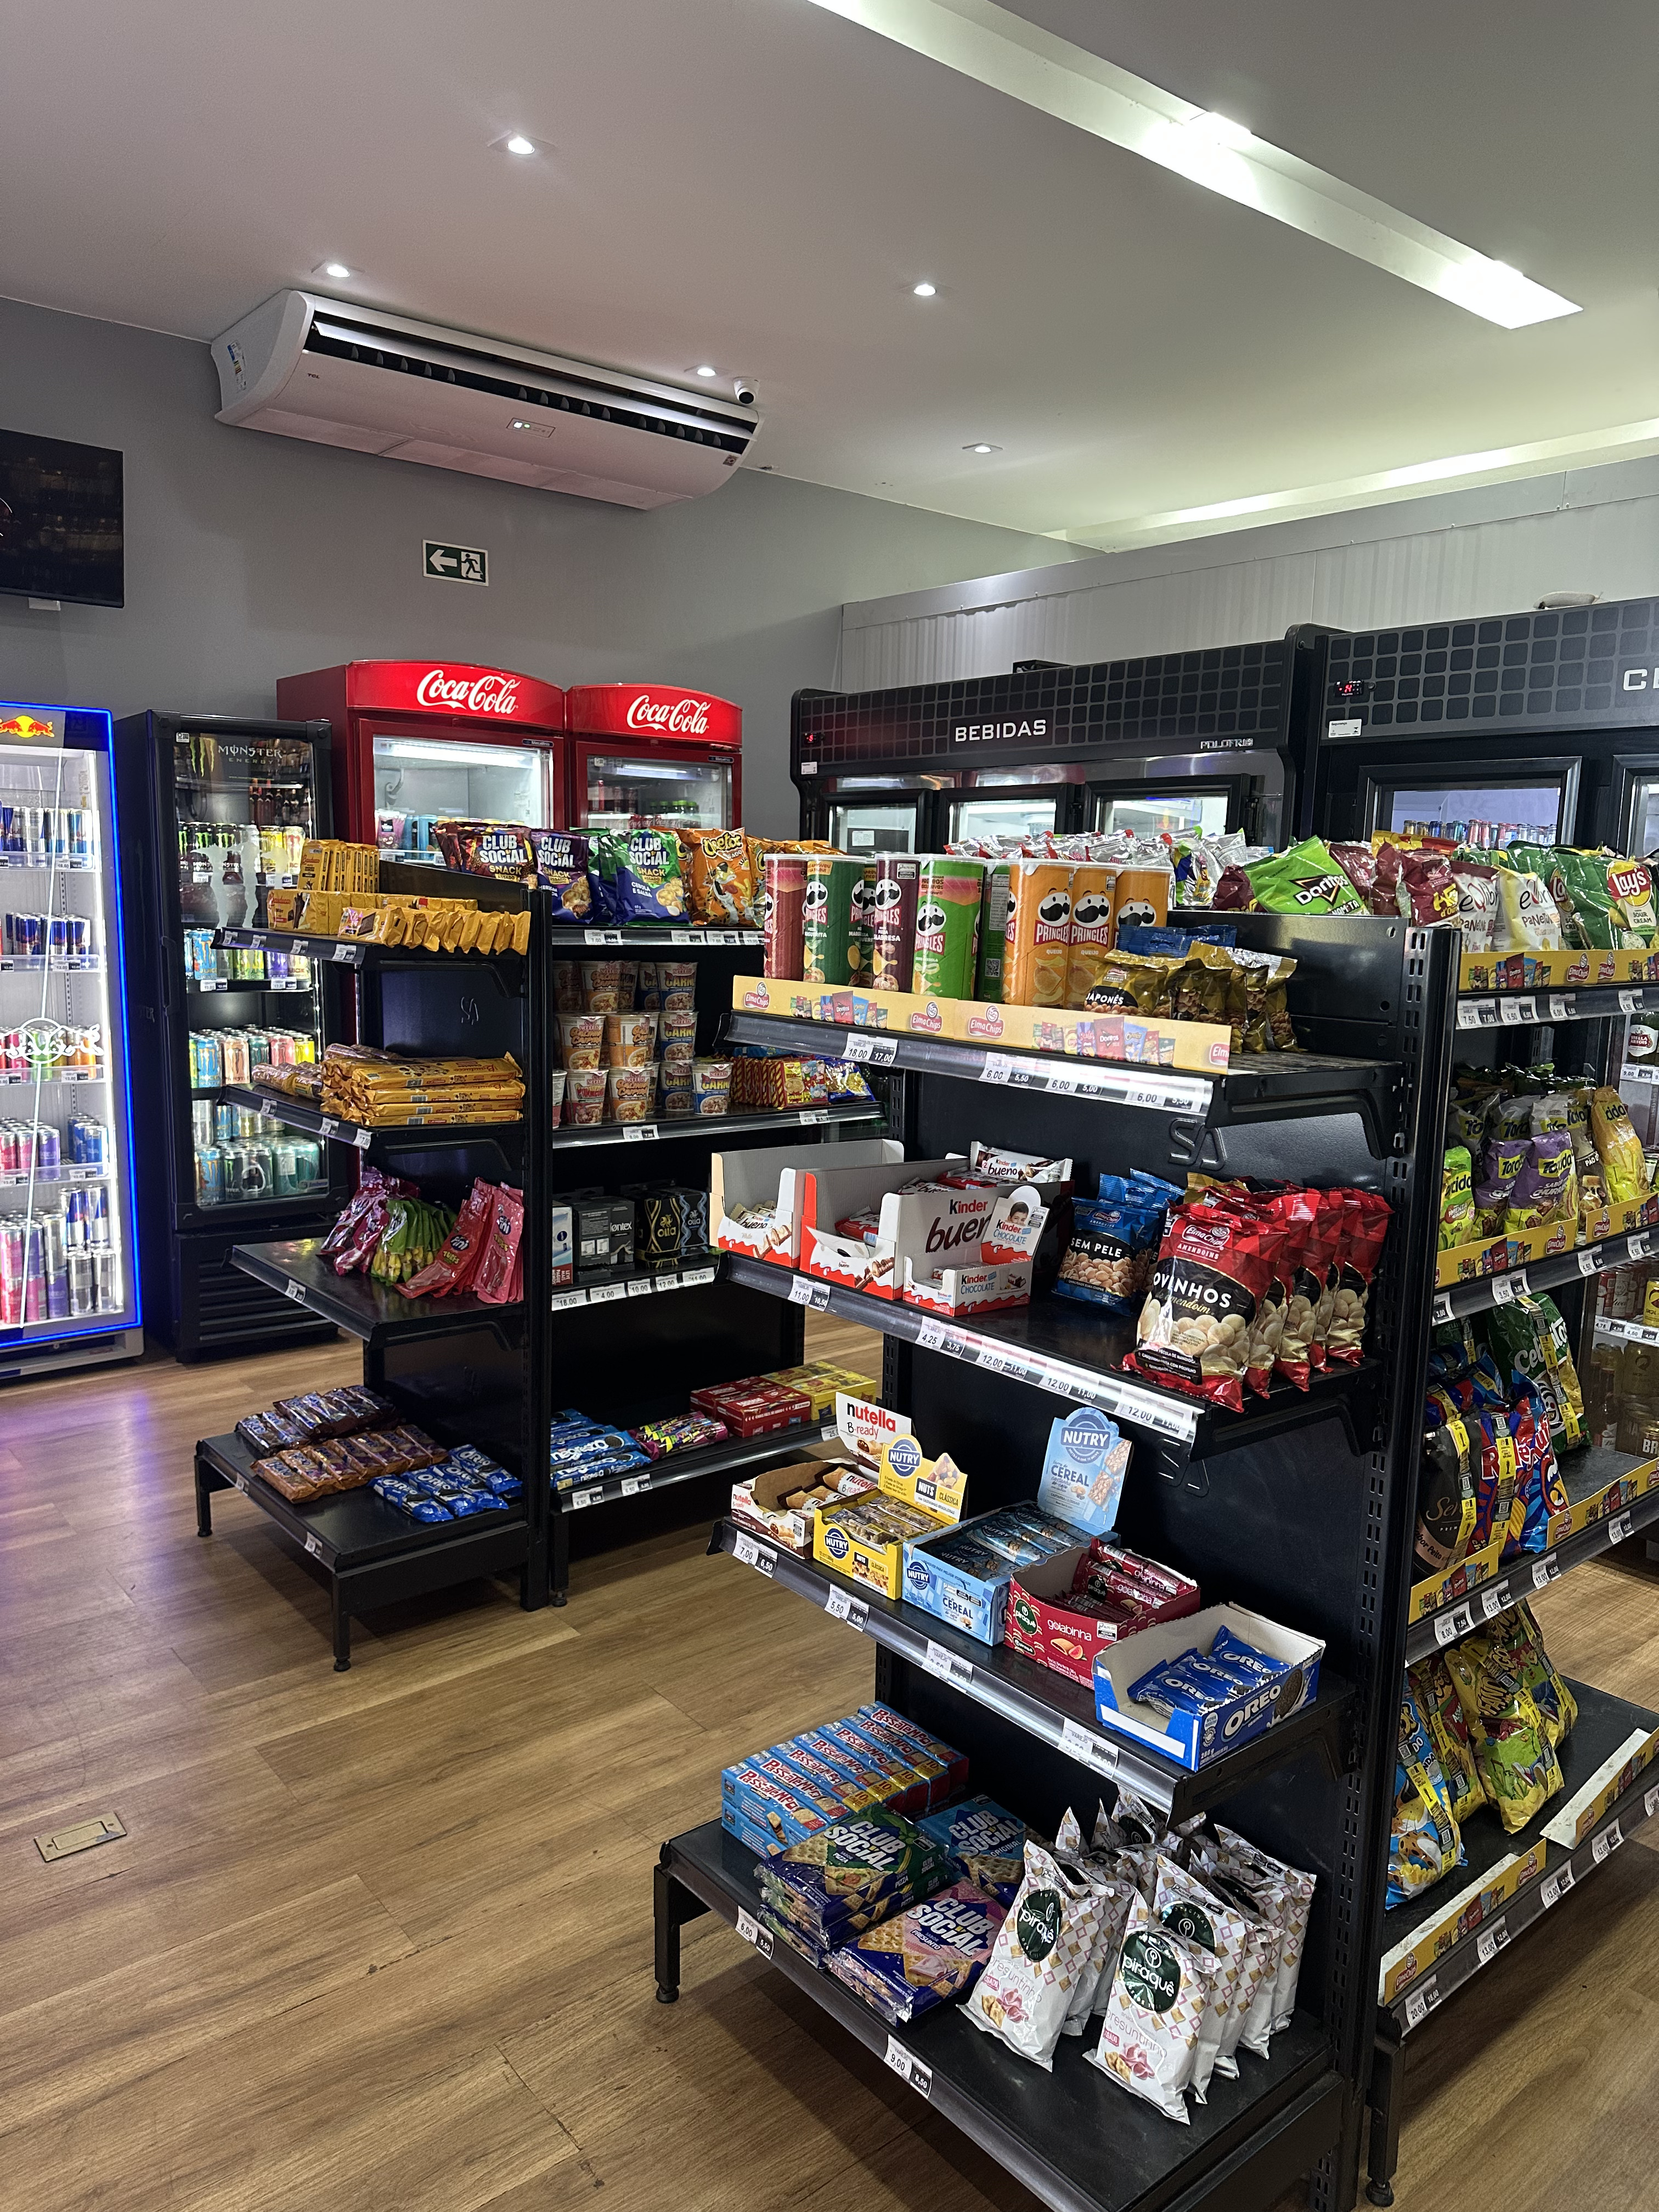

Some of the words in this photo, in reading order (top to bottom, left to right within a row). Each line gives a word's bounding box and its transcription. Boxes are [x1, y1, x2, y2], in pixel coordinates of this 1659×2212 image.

[417, 669, 521, 714] Coca-Cola
[627, 695, 711, 735] Coca-Cola
[955, 719, 1047, 743] BEBIDAS
[1200, 738, 1253, 749] POLOFRIO
[218, 745, 283, 759] MONSTER
[483, 836, 517, 850] CLUB
[541, 837, 571, 853] CLUB
[631, 838, 662, 851] CLUB
[489, 866, 522, 875] SNACK
[544, 867, 571, 878] SNACK
[636, 867, 665, 877] SNACK
[631, 882, 651, 891] CEBOLA
[1613, 867, 1648, 896] Lay's
[636, 889, 652, 898] SALSA
[1294, 874, 1347, 905] Doritos
[1037, 924, 1069, 943] PRINGLES
[1071, 926, 1108, 945] PRINGLES
[1085, 990, 1124, 1005] JAPONÊS
[1463, 1016, 1476, 1024] 7,50
[1483, 1014, 1494, 1023] 7,00
[1506, 1012, 1517, 1020] 6,50
[849, 1048, 867, 1058] 18,00
[875, 1053, 893, 1062] 17,00
[986, 1070, 1003, 1079] 6,00
[1015, 1074, 1029, 1082] 5,50
[1052, 1080, 1069, 1090] 6,00
[1082, 1084, 1097, 1093] 5,00
[1137, 1093, 1157, 1103] 6,00
[995, 1159, 1010, 1167] Kinder
[988, 1165, 1017, 1176] bueno
[949, 1198, 988, 1215] Kinder
[741, 1218, 768, 1229] bueno
[996, 1220, 1021, 1235] Kinder
[657, 1226, 676, 1237] olla
[994, 1230, 1026, 1245] CHOCOLATE
[1071, 1238, 1091, 1250] SEM
[1094, 1243, 1122, 1257] PELE
[1177, 1243, 1219, 1260] AMENDOINS
[961, 1274, 988, 1285] Kinder
[961, 1283, 995, 1295] CHOCOLATE
[1153, 1272, 1231, 1308] OVINHOS
[1498, 1289, 1510, 1299] 3,50
[795, 1291, 809, 1301] 11,00
[815, 1297, 827, 1306] 10,50
[1165, 1294, 1211, 1314] amendoim
[922, 1333, 937, 1345] 4,25
[947, 1342, 960, 1352] 3,75
[983, 1355, 1003, 1368] 12,00
[1048, 1378, 1069, 1391] 12,00
[1077, 1388, 1096, 1400] 11,00
[847, 1401, 896, 1432] nutella
[1128, 1406, 1152, 1421] 12,00
[847, 1421, 879, 1438] B-ready
[1063, 1430, 1108, 1446] NUTRY
[551, 1435, 610, 1461] negresco
[890, 1452, 919, 1464] NUTRY
[417, 1474, 450, 1489] OREO
[446, 1467, 479, 1484] OREO
[1051, 1465, 1089, 1487] CEREAL
[383, 1479, 417, 1494] OREO
[918, 1481, 934, 1497] NUTS
[733, 1493, 751, 1505] nutella
[939, 1492, 958, 1506] CLÁSSICA
[826, 1538, 848, 1550] NUTRY
[741, 1547, 753, 1560] 7,00
[856, 1554, 866, 1564] NUTS
[941, 1552, 969, 1564] NUTRY
[1429, 1546, 1441, 1560] Peito
[760, 1559, 773, 1571] 6,50
[908, 1570, 929, 1582] NUTRY
[1536, 1573, 1547, 1584] 13,00
[831, 1601, 844, 1614] 5,50
[943, 1597, 973, 1619] CEREAL
[1486, 1601, 1499, 1612] 13,00
[851, 1612, 863, 1625] 5,00
[1457, 1619, 1466, 1628] 7,50
[1047, 1619, 1092, 1641] goiabinha
[1442, 1627, 1453, 1638] 8,00
[1223, 1652, 1272, 1673] OREO
[1193, 1663, 1244, 1685] OREO
[1165, 1678, 1215, 1701] OREO
[1224, 1685, 1281, 1736] OREO
[1071, 1731, 1087, 1743] VAREJO
[949, 1810, 998, 1840] CLUB
[850, 1821, 906, 1853] CLUB
[990, 1839, 1023, 1857] ORIGINAL
[833, 1853, 849, 1864] PIZZA
[895, 1874, 909, 1888] PIZZA
[1547, 1887, 1559, 1900] 13,00
[901, 1895, 914, 1907] PIZZA
[933, 1897, 994, 1936] CLUB
[740, 1922, 753, 1938] 6,00
[911, 1928, 941, 1950] PRESUNTO
[760, 1939, 771, 1953] 5,50
[1482, 1943, 1495, 1957] 13,00
[1122, 1954, 1175, 1997] piraquê
[1411, 2002, 1425, 2019] 20,00
[889, 2052, 906, 2072] 9,00
[913, 2072, 928, 2090] 8,50
